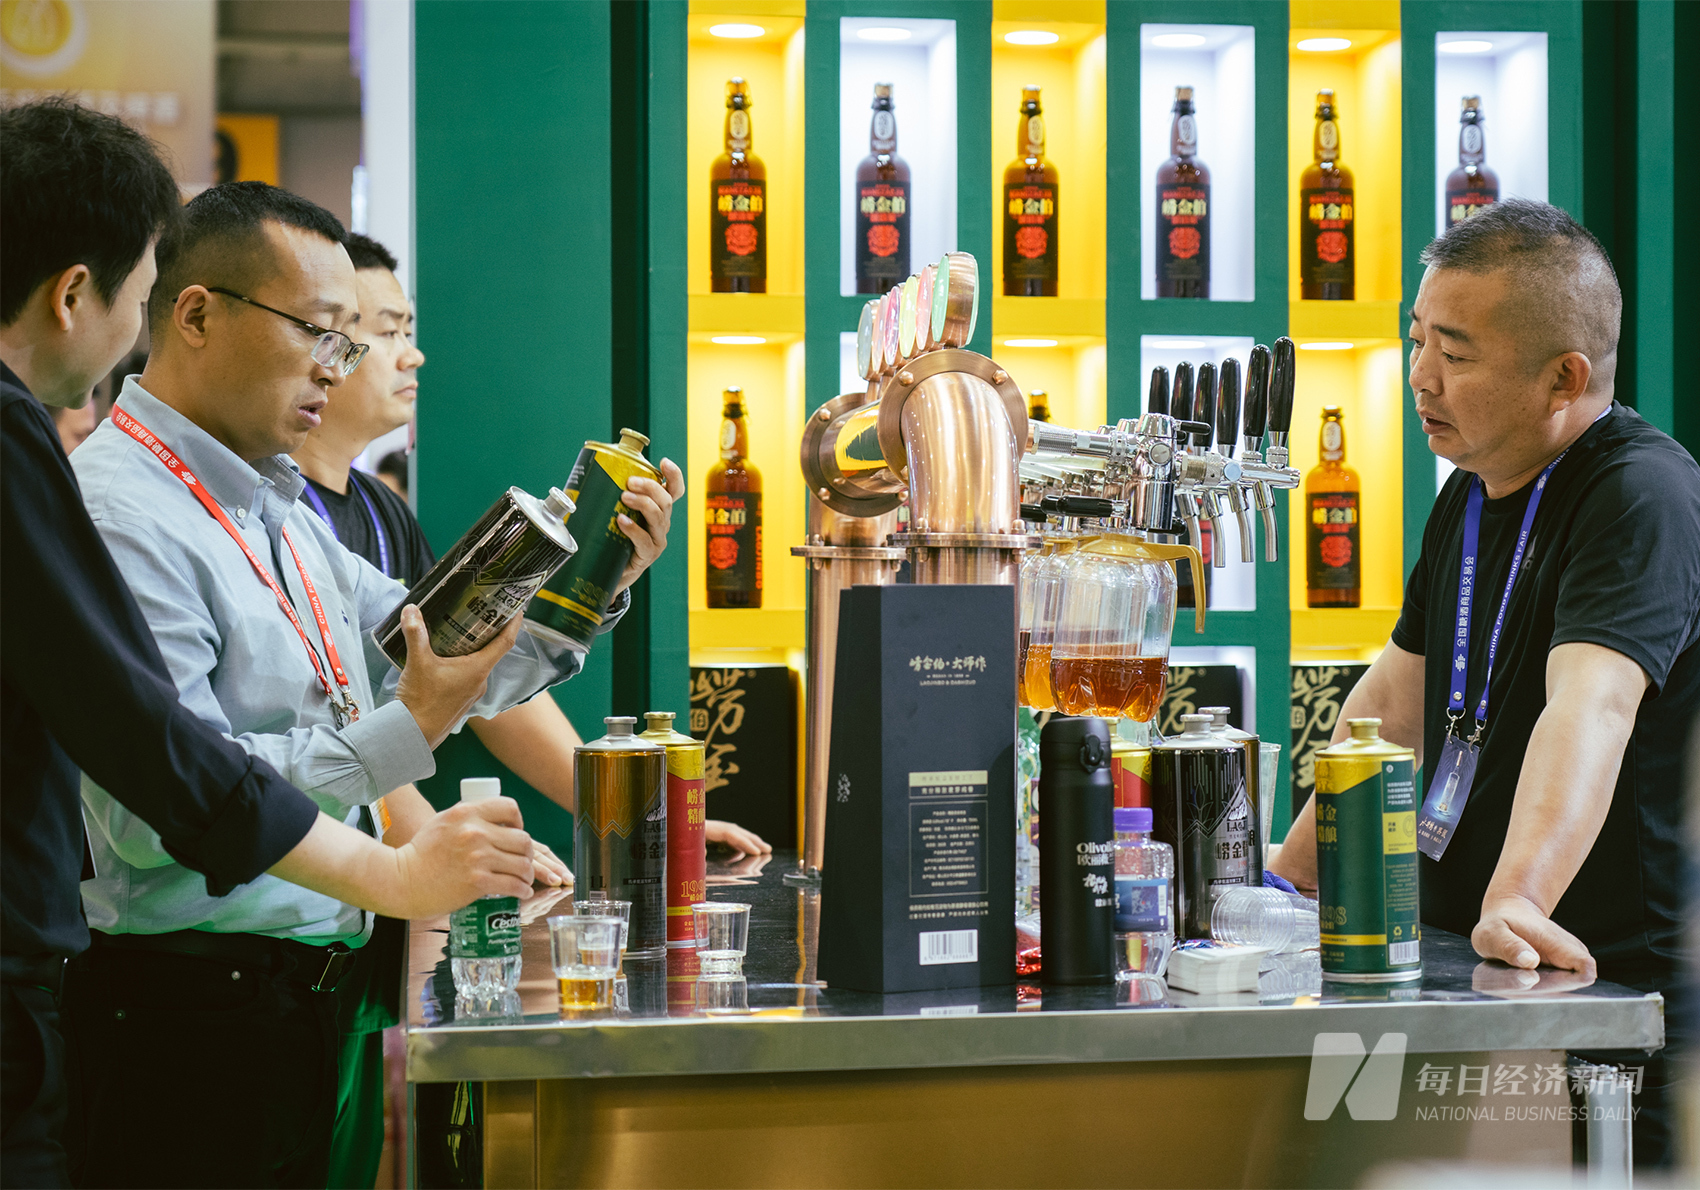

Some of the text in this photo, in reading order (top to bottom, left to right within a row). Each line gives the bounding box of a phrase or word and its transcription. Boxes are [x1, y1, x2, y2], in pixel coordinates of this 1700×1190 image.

[114, 411, 181, 470] 全国糖酒商品交易会
[311, 596, 326, 625] CHINA
[1456, 556, 1474, 648] 全国糖酒商品交易会
[1488, 627, 1500, 659] CHINA
[1516, 529, 1528, 553] FAIR
